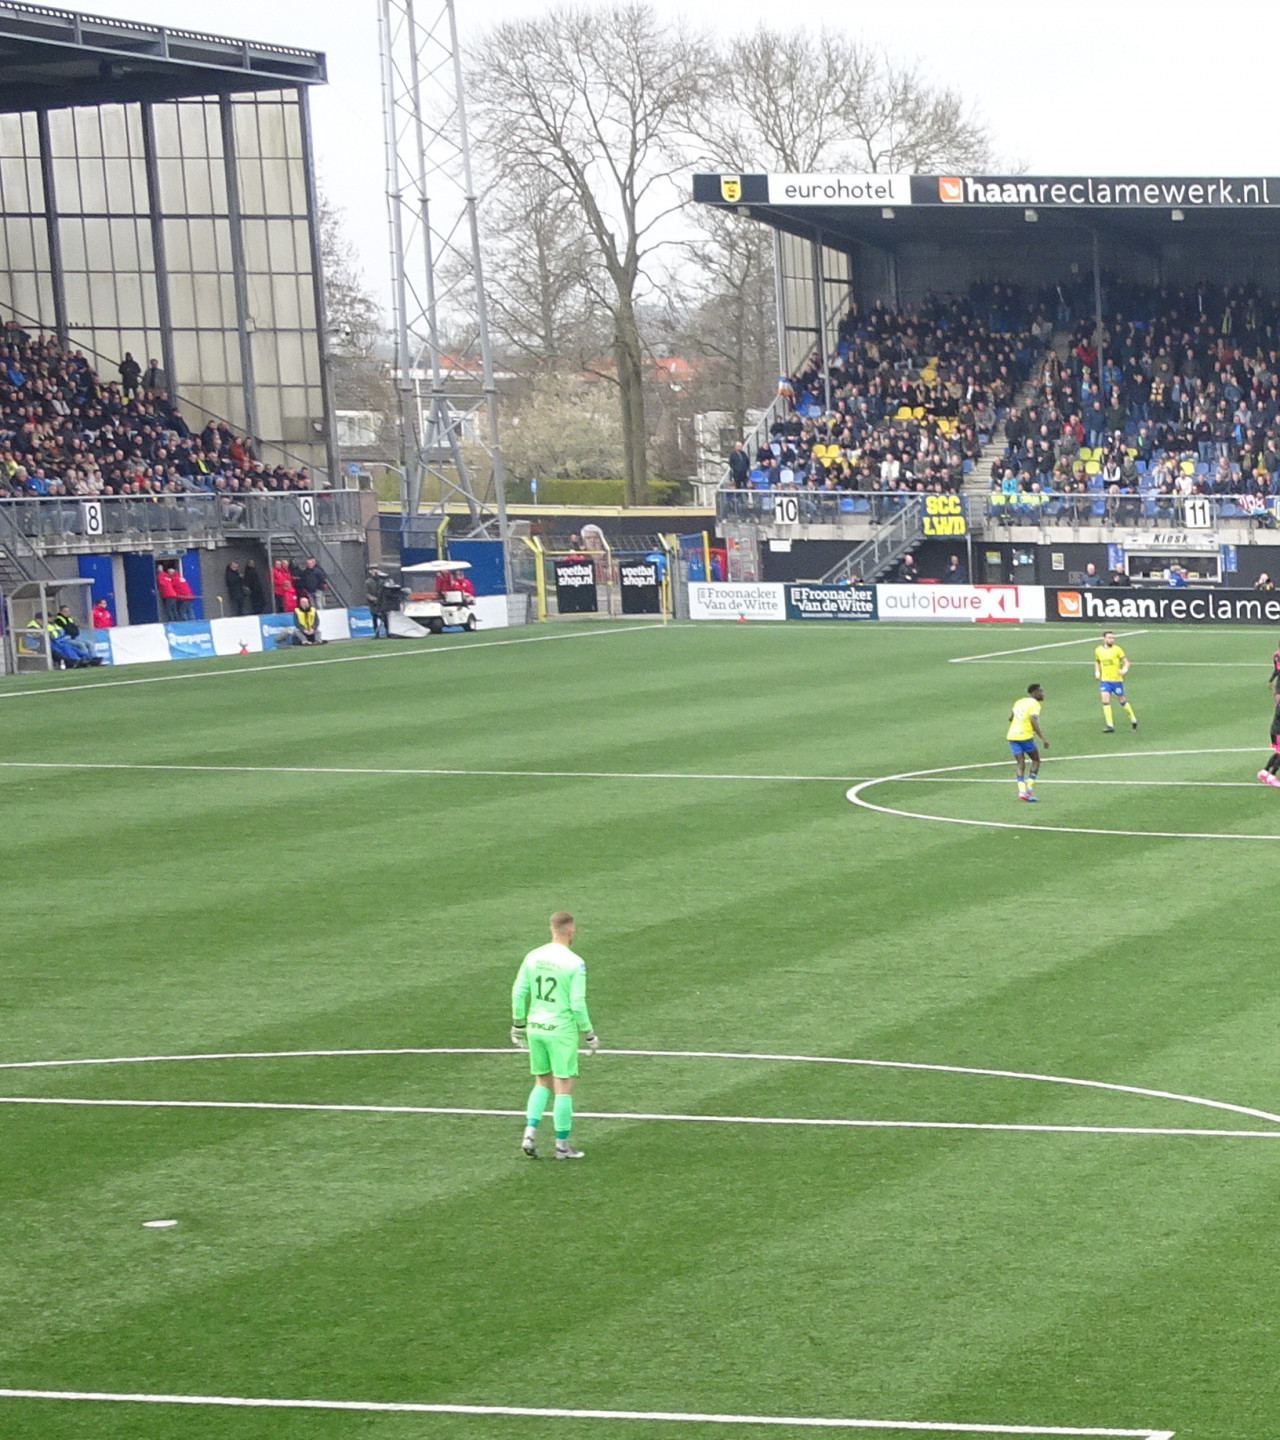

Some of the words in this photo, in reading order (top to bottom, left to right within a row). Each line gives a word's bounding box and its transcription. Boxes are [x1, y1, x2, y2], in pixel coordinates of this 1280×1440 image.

[784, 179, 894, 199] eurohotel
[965, 177, 1270, 204] haanreclamewerk.nl
[302, 498, 313, 524] 9
[778, 499, 798, 522] 10
[925, 495, 962, 515] SCC
[88, 505, 100, 532] 8
[1188, 503, 1208, 525] 11
[923, 515, 966, 536] LWD
[1152, 533, 1189, 544] Kiosk
[557, 564, 593, 576] voetbal
[622, 565, 655, 576] voetbal
[558, 575, 594, 587] shop.nl
[623, 575, 656, 587] shop.nl
[707, 587, 777, 599] Froonacker
[801, 587, 873, 601] Froonacker
[704, 599, 730, 611] Van
[731, 599, 743, 611] de
[743, 599, 779, 611] Witte
[798, 600, 823, 612] Van
[824, 600, 837, 612] de
[837, 599, 873, 612] Witte
[534, 975, 558, 1003] 12
